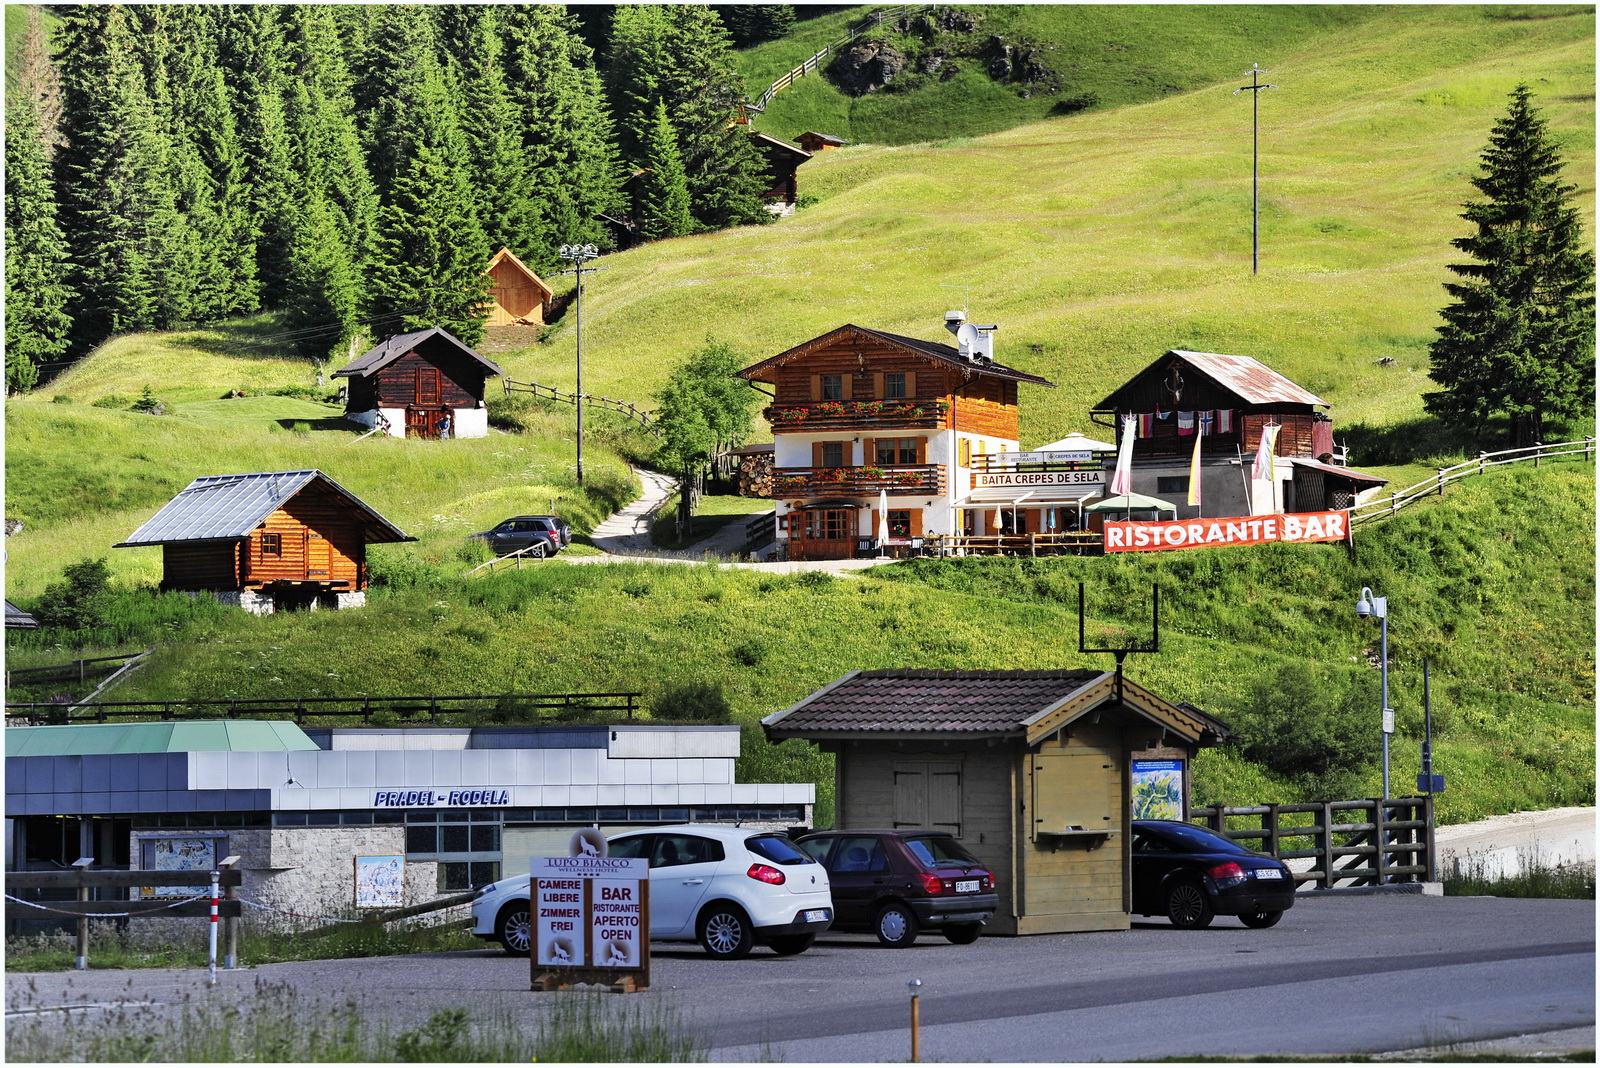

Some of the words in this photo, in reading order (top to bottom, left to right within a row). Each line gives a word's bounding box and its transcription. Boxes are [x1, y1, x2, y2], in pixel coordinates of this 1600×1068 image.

[982, 475, 1012, 485] BAITA
[1015, 474, 1054, 484] CREPES
[1057, 473, 1070, 483] DE
[1073, 472, 1099, 482] SELA
[1107, 519, 1277, 547] RISTORANTE
[1283, 513, 1346, 540] BAR
[548, 859, 579, 867] LUPO
[583, 859, 630, 868] BIANCO
[538, 880, 581, 890] CAMERE
[543, 893, 580, 903] LIBERE
[601, 887, 632, 901] BAR
[540, 908, 580, 918] ZIMMER
[593, 903, 640, 913] RISTORANTE
[550, 921, 574, 931] FREI
[594, 916, 639, 927] APERTO
[601, 929, 632, 940] OPEN
